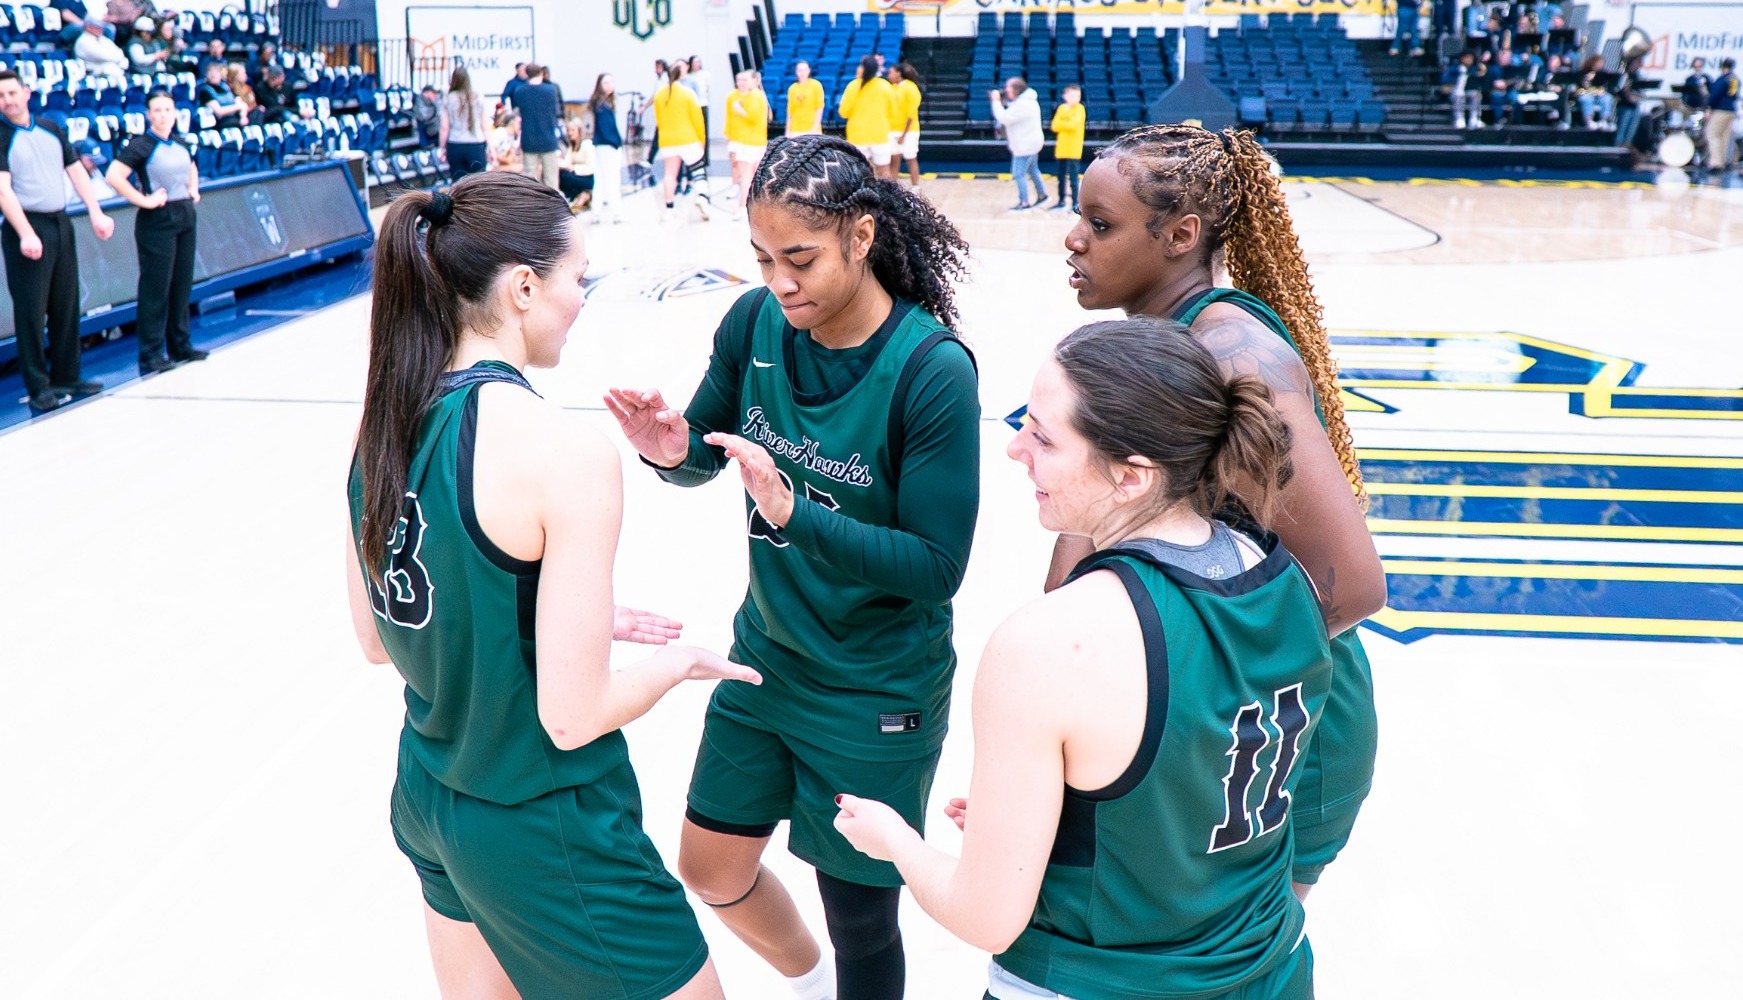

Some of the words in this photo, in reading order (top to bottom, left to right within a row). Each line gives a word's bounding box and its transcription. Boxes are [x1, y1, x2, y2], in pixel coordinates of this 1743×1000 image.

[613, 0, 672, 40] UCO
[910, 718, 916, 727] L
[1206, 682, 1310, 853] 11
